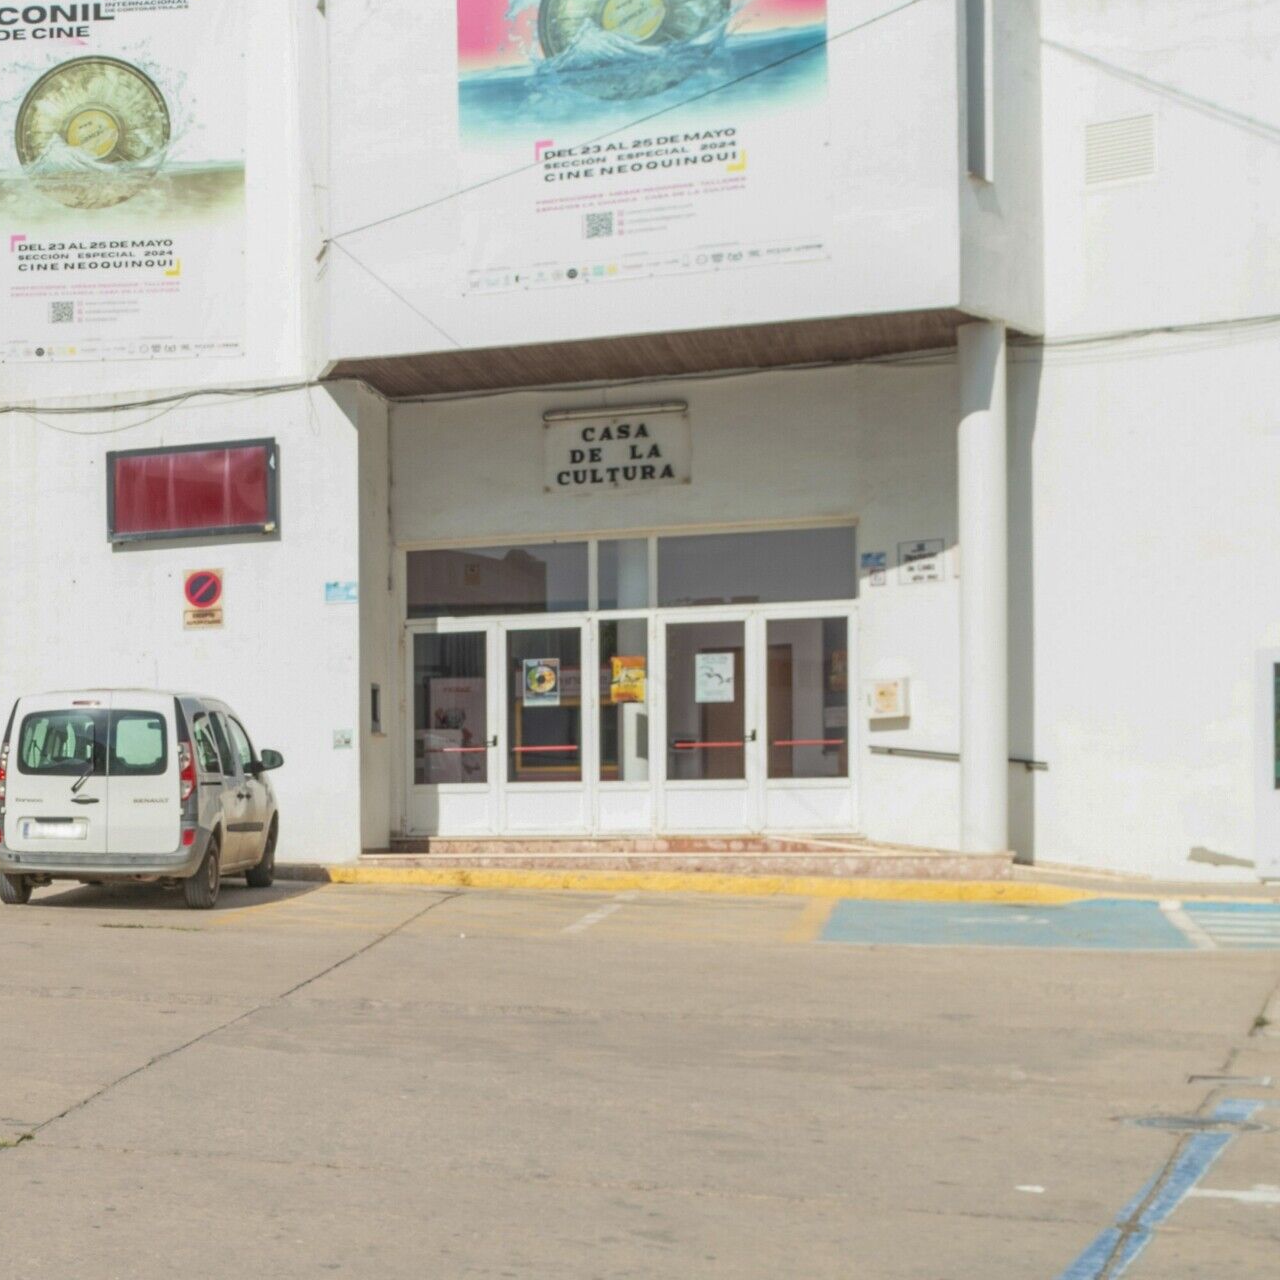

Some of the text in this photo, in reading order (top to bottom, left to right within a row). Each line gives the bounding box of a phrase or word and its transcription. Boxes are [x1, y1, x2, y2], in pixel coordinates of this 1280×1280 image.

[105, 0, 188, 7] INTERNACIONAL
[32, 26, 89, 39] CINE
[544, 128, 736, 160] DEL 23 AL 25 DE MAYO
[617, 147, 688, 161] ESPECIAL
[700, 140, 736, 150] 2024
[544, 152, 736, 182] CINE NEOQUINQUI
[18, 244, 45, 252] DEL
[68, 242, 87, 250] AL
[90, 241, 107, 249] 25
[131, 239, 173, 248] MAYO
[78, 251, 135, 259] ESPECIAL
[18, 259, 173, 271] CINE NEOQUINQUI
[581, 423, 649, 442] CASA
[570, 443, 662, 464] DE LA
[557, 464, 675, 486] CULTURA
